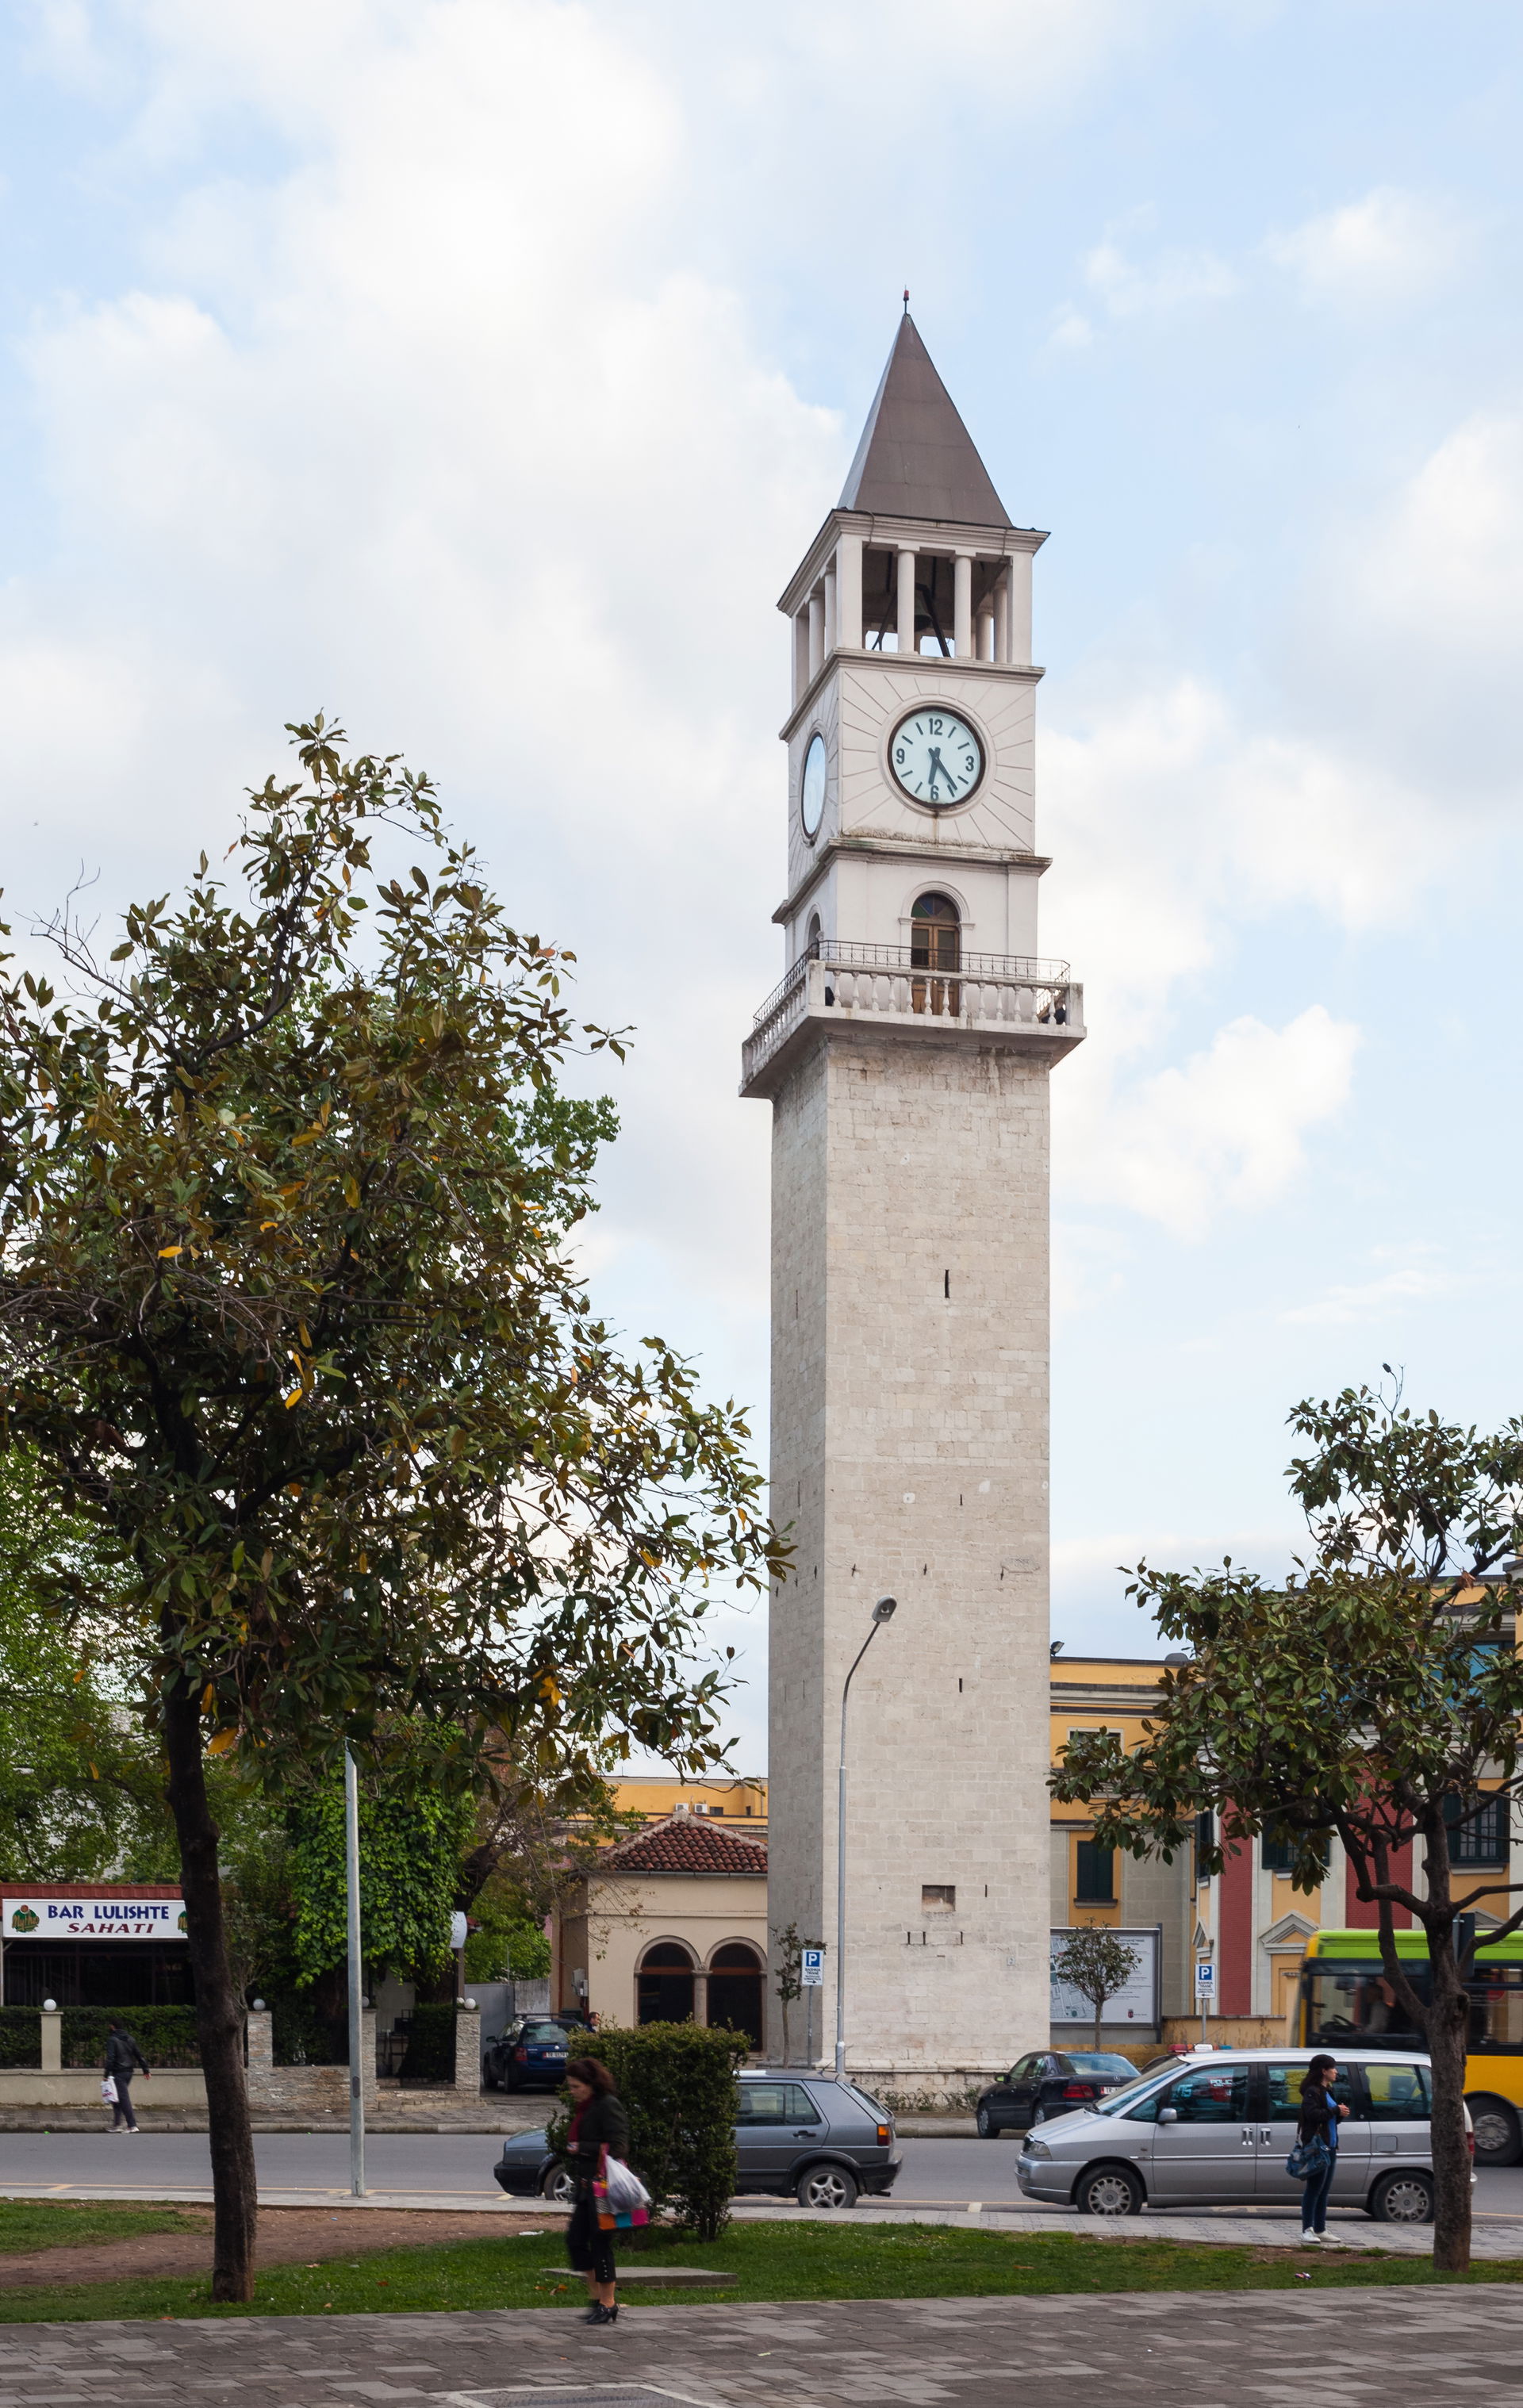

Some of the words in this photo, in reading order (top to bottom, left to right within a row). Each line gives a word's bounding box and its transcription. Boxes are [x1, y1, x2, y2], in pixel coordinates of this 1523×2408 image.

[929, 718, 942, 735] 12
[896, 748, 905, 765] 9
[965, 755, 975, 773] 3
[930, 784, 939, 801] 6
[48, 1904, 84, 1919] BAR
[94, 1905, 170, 1919] LULISHTE
[67, 1923, 154, 1934] SAHATI
[808, 1953, 818, 1966] P
[1201, 1967, 1210, 1979] P
